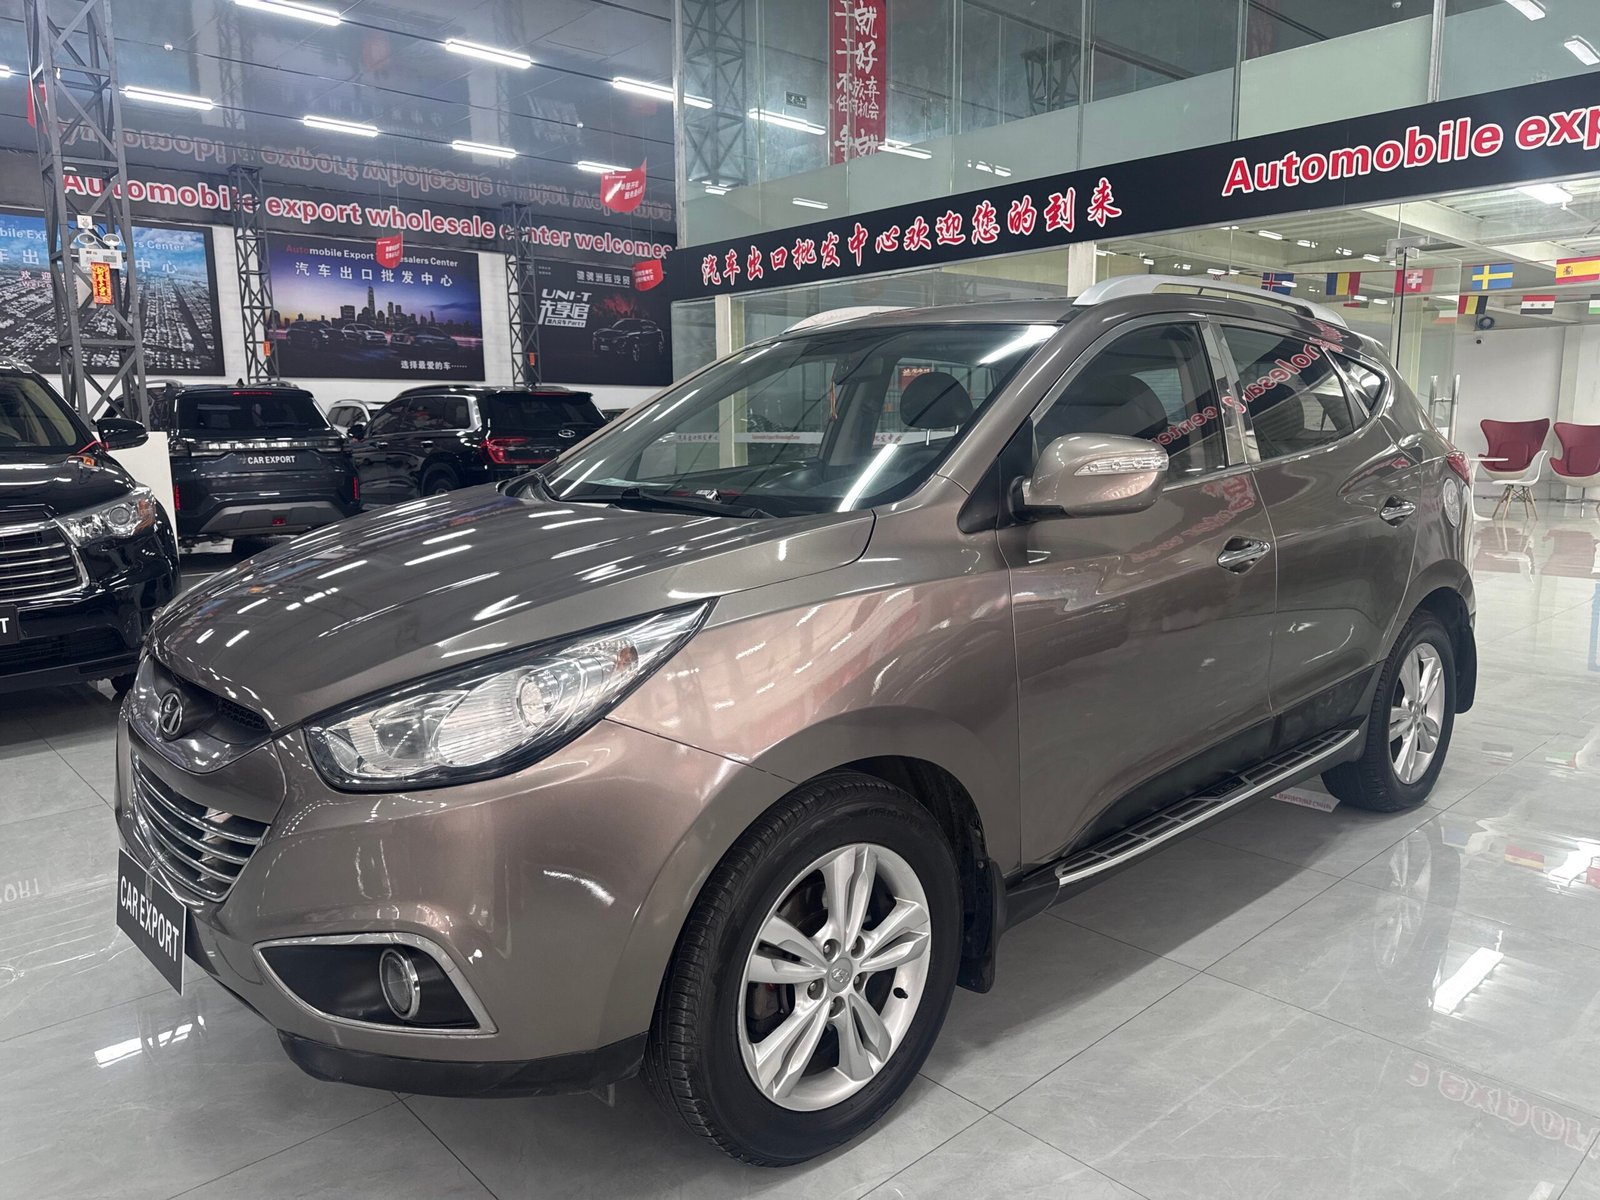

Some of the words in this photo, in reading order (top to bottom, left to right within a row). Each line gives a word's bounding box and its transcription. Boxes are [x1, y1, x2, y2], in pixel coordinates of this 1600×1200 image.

[1221, 116, 1503, 197] Automobile
[266, 194, 362, 224] export
[366, 205, 495, 240] wholesale
[701, 177, 1123, 286] 汽车出口批发中心欢迎您的到来
[147, 240, 185, 252] Center
[285, 244, 342, 258] Automobile
[343, 250, 375, 262] Export
[430, 256, 459, 268] Center
[295, 260, 453, 287] 汽车出口批发中心
[541, 288, 592, 303] UNI-T
[247, 456, 265, 465] CAR
[264, 455, 296, 464] EXPORT
[120, 875, 139, 921] CAR
[139, 893, 180, 962] EXPORT
